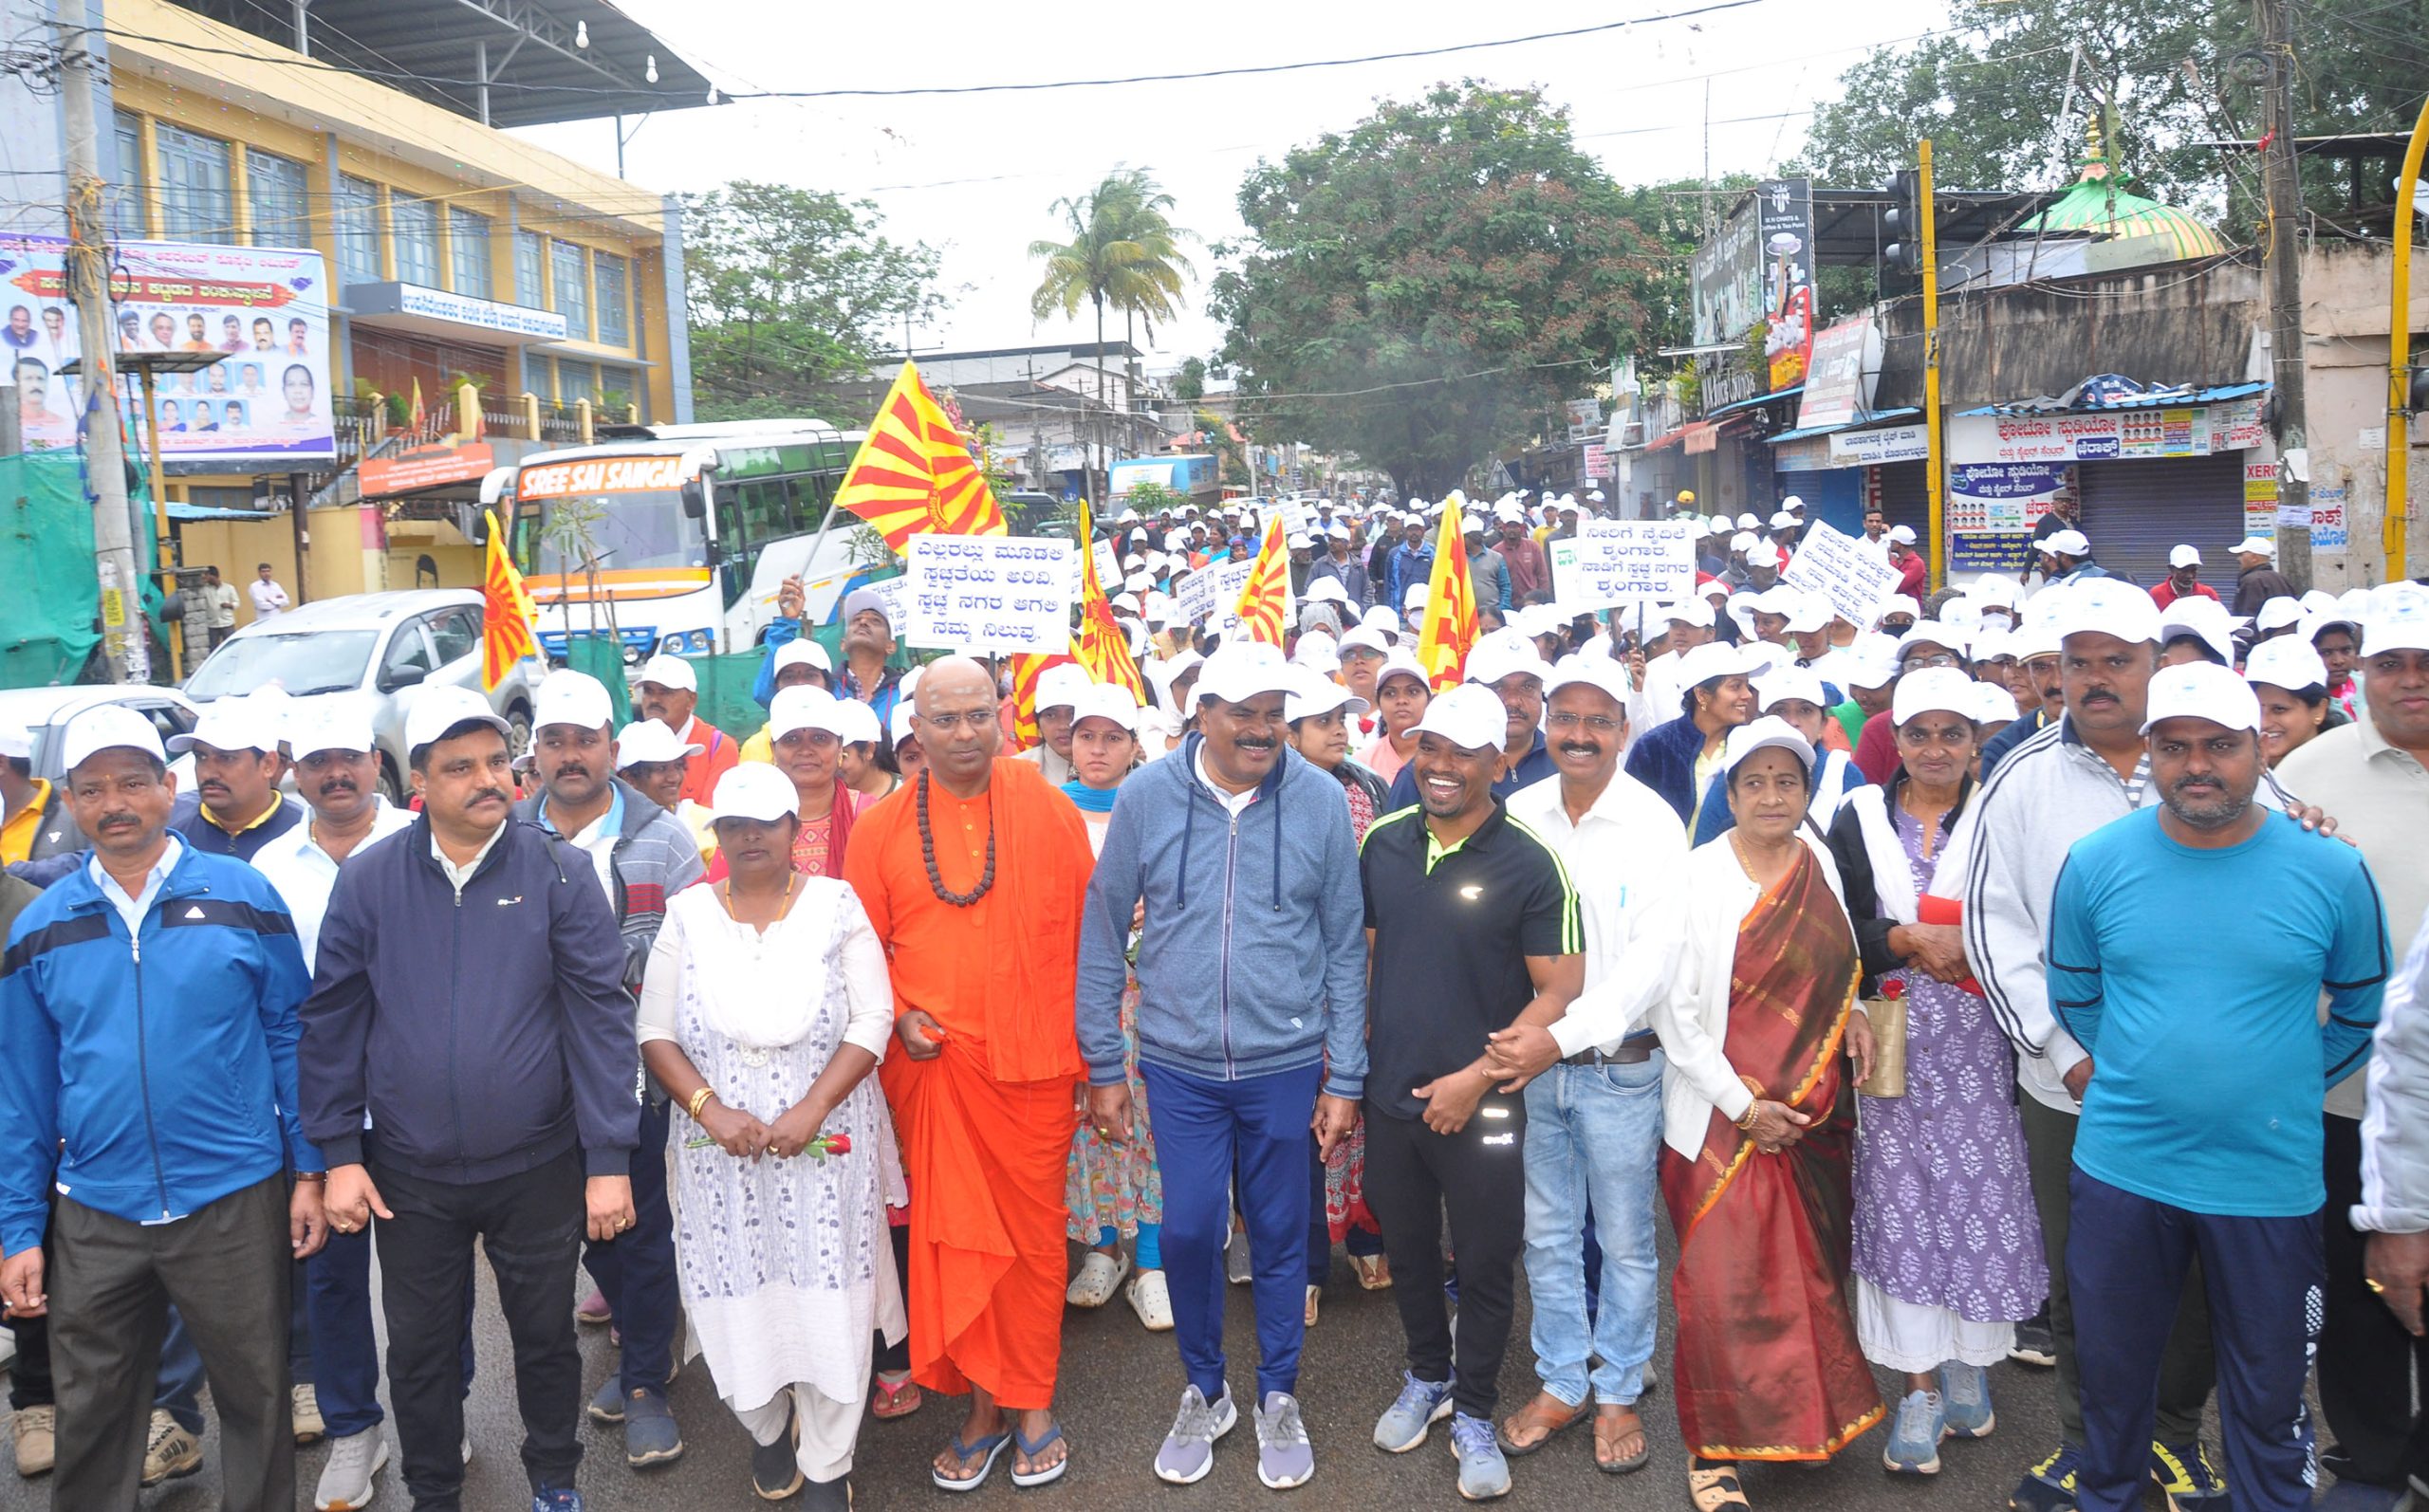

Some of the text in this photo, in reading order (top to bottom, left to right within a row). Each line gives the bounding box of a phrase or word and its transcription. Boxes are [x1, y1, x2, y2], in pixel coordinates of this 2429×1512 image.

[522, 467, 568, 497] SREE
[569, 463, 605, 491] SAI
[605, 460, 686, 489] SANGA
[2246, 464, 2278, 478] XERO
[1586, 526, 1633, 539] ನೀರಿಗೆ
[918, 542, 1064, 562] ಎಲ್ಲರಲ್ಲು ಮೂಡಲಿ
[1655, 563, 1690, 574] ನಗರ
[958, 595, 1003, 610] ನಗರ
[1013, 598, 1058, 613] ಆಗಲಿ
[933, 619, 973, 643] ನಮ್ಮ
